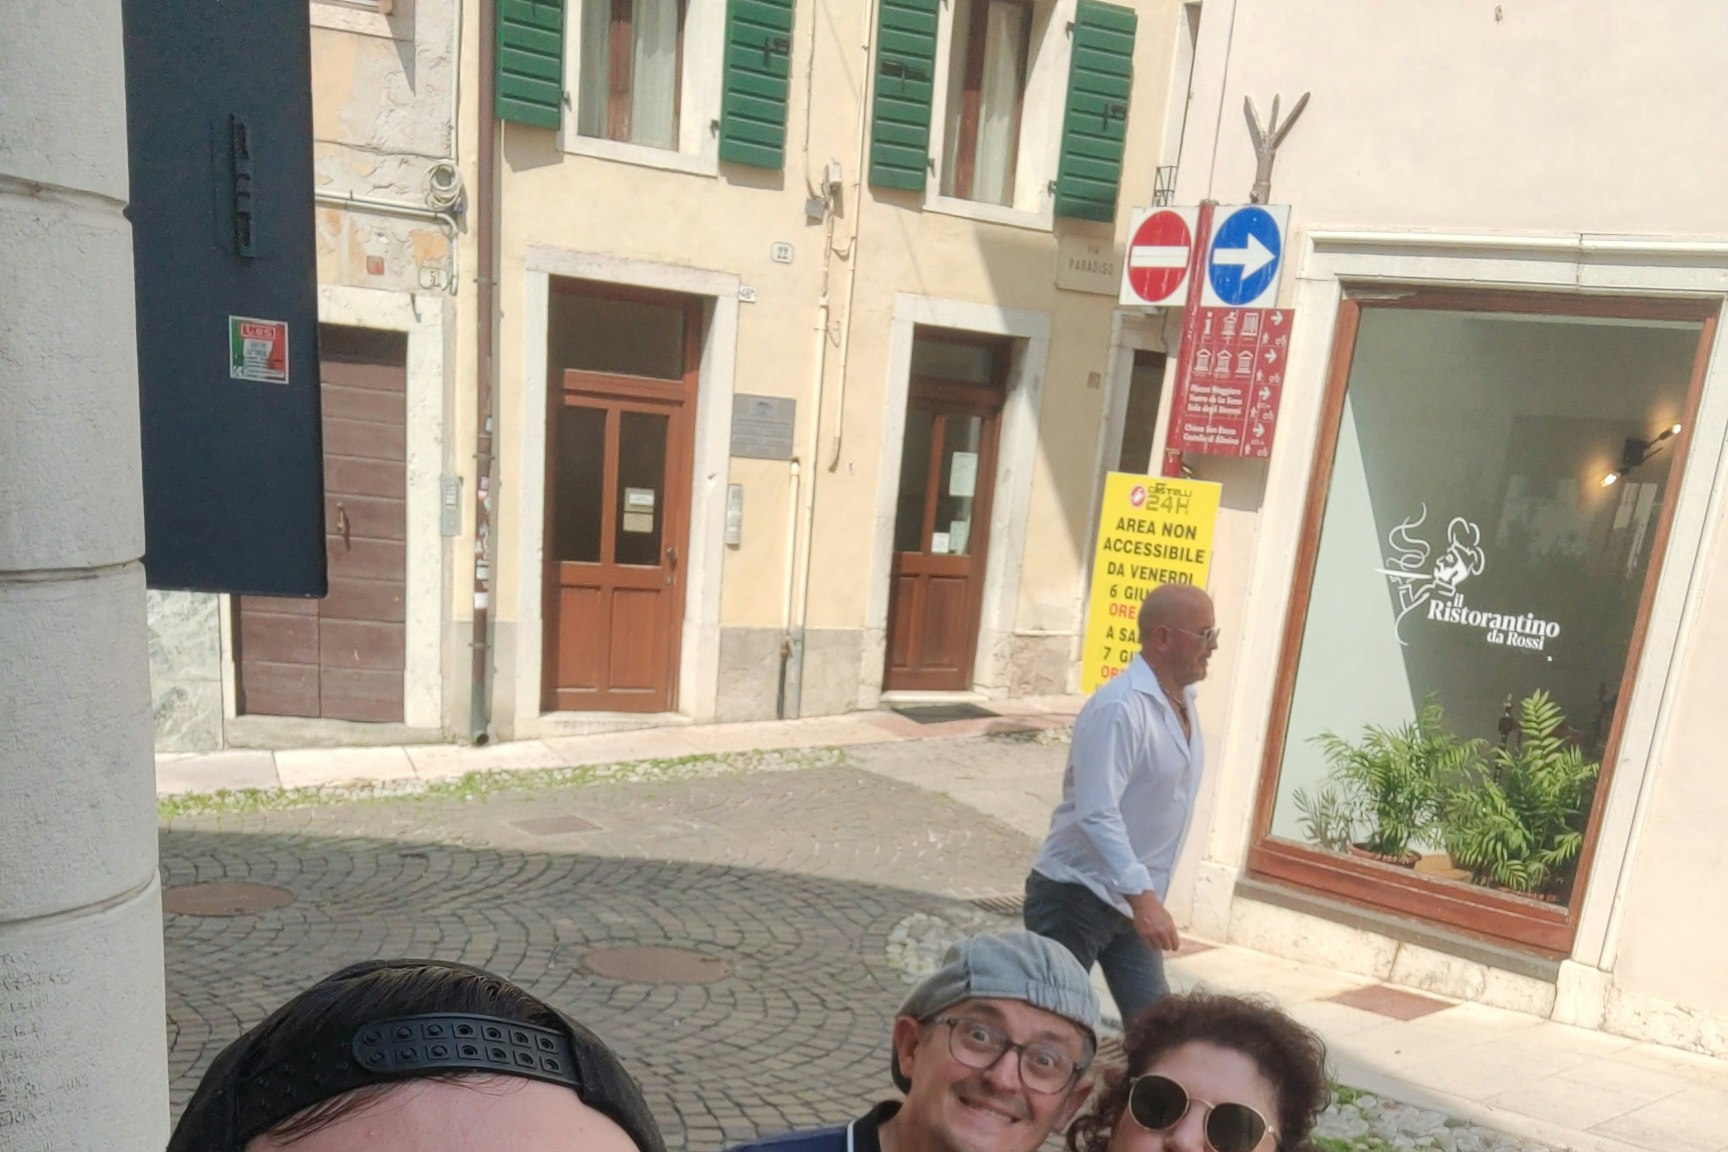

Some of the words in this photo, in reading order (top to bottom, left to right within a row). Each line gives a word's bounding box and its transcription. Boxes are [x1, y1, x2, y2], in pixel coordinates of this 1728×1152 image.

[777, 246, 788, 259] 22
[1068, 258, 1113, 275] PARADISO
[1145, 494, 1191, 515] 24H
[1115, 516, 1156, 535] AREA
[1161, 521, 1197, 540] NON
[1103, 537, 1206, 564] ACCESSIBILE
[1107, 561, 1125, 577] DA
[1109, 584, 1118, 599] 6
[1124, 585, 1151, 602] GIU
[1453, 592, 1465, 608] il
[1109, 602, 1137, 620] ORE
[1427, 599, 1561, 639] Ristorantino
[1105, 625, 1115, 639] A
[1119, 627, 1139, 643] SA
[1486, 629, 1504, 644] da
[1506, 631, 1546, 650] Rossi
[1103, 646, 1112, 661] 7
